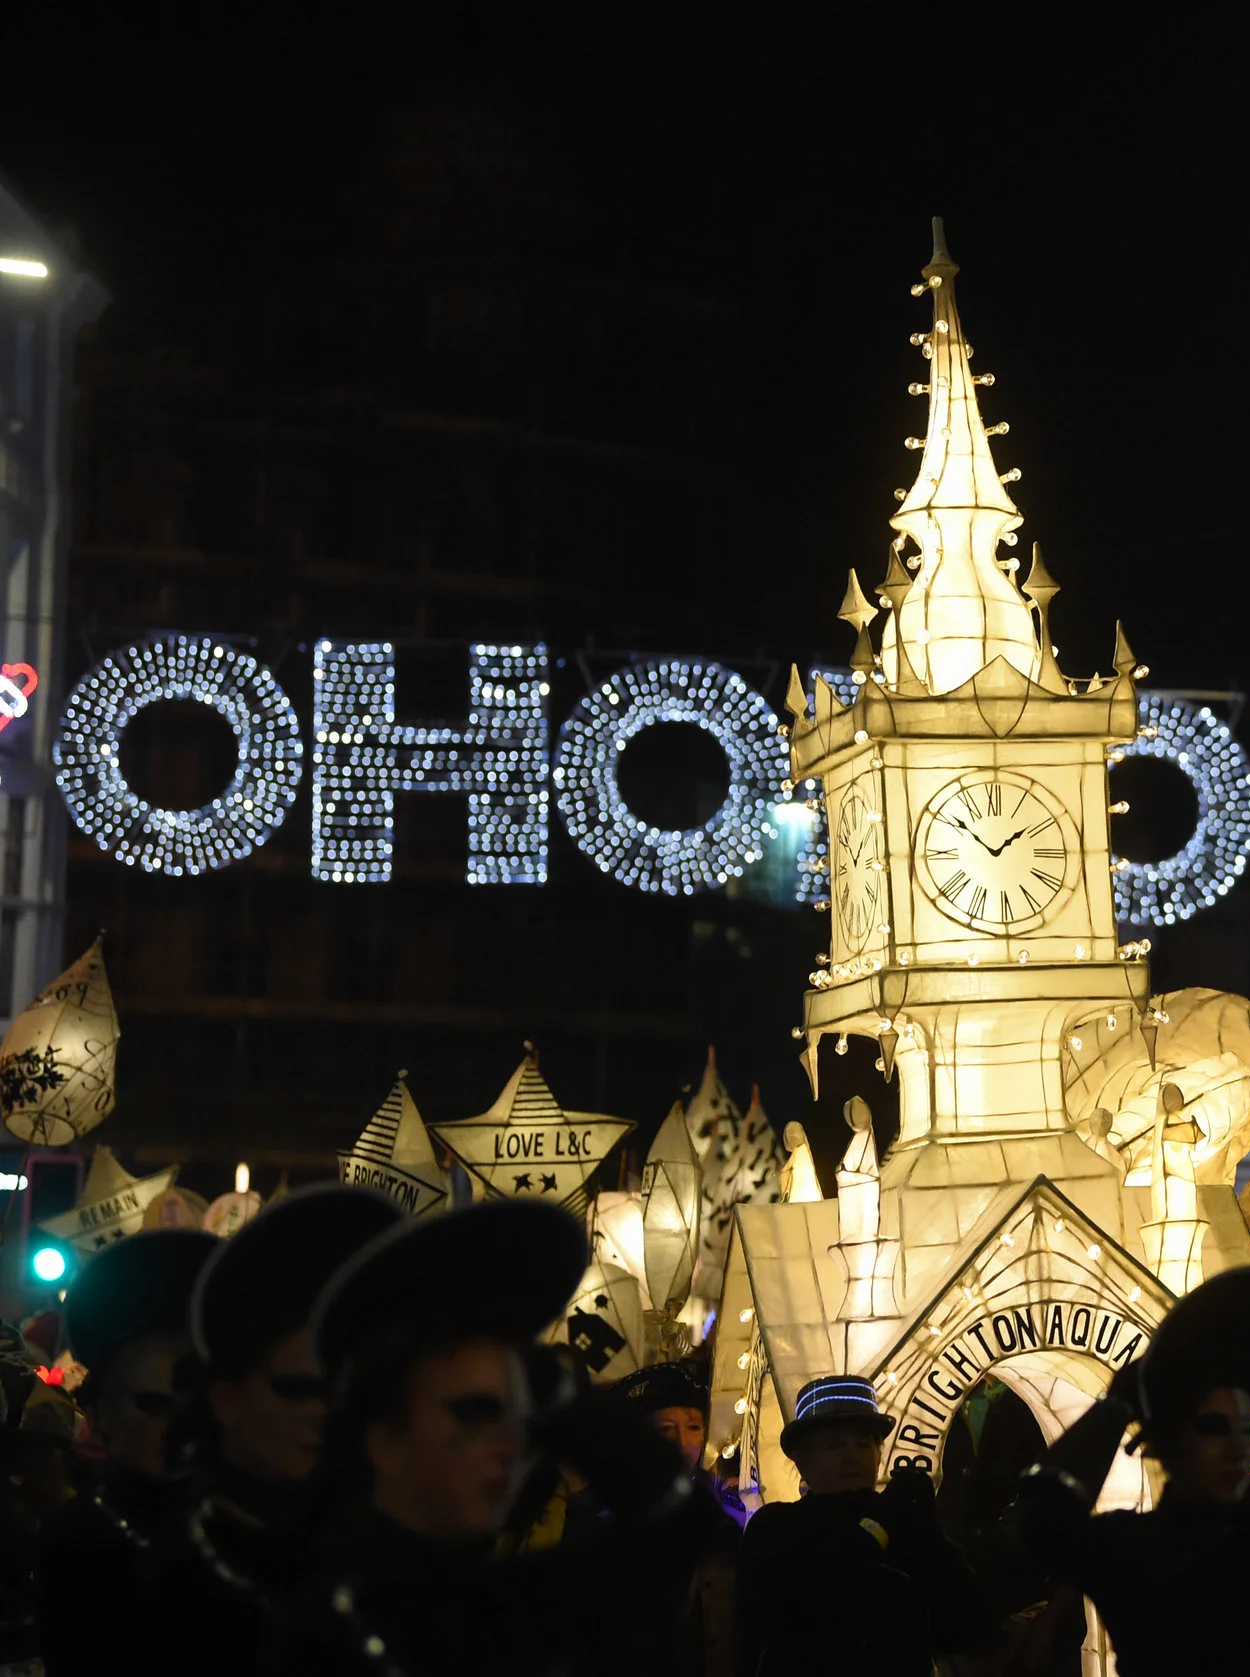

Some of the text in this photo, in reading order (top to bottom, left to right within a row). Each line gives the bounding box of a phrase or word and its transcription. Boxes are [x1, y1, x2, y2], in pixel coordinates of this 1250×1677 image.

[494, 1130, 592, 1159] LOVE L&C
[78, 1190, 140, 1229] REMAIN
[354, 1165, 420, 1215] BRIGHTON
[891, 1308, 1038, 1473] BRIGHTON
